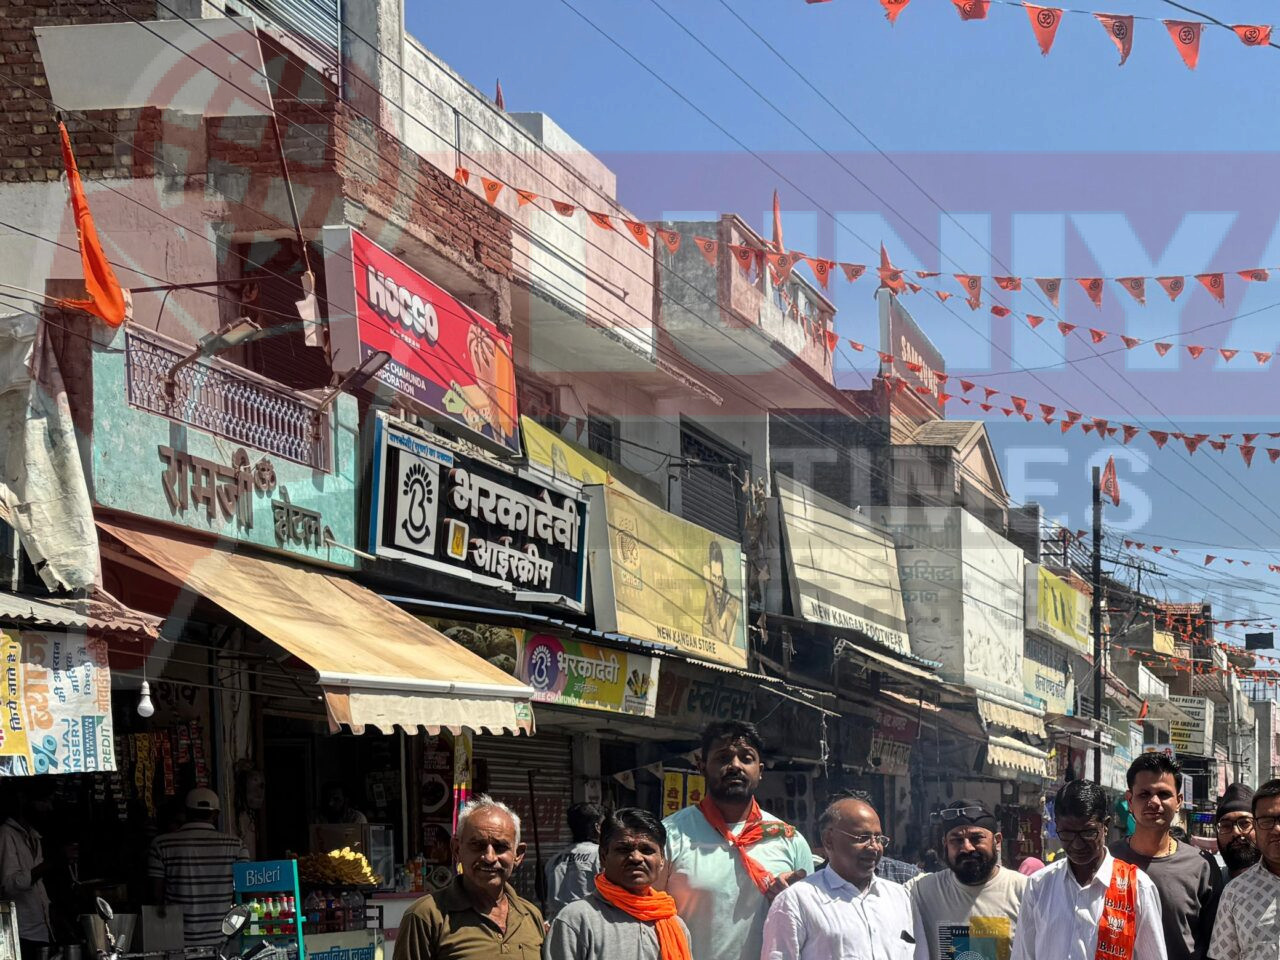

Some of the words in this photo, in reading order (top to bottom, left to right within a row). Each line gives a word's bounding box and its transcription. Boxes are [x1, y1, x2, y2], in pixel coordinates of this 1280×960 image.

[367, 264, 439, 347] HOCCO
[390, 362, 427, 391] CHAMUNDA
[157, 446, 255, 535] रामजी
[271, 485, 322, 550] होटल
[451, 467, 581, 553] भरकादेवी
[656, 624, 672, 639] NEW
[672, 630, 699, 650] KANGAN
[698, 637, 717, 654] STORE
[811, 601, 830, 621] NEW
[831, 608, 864, 632] KANGAN
[865, 621, 904, 649] FOOTWEAR
[52, 641, 63, 684] आसान
[556, 650, 620, 684] भरकादेवी
[6, 667, 18, 698] जाते
[22, 632, 55, 732] ब्याज
[6, 701, 23, 732] किये
[1176, 742, 1189, 750] IZZA
[246, 866, 281, 887] Bisleri
